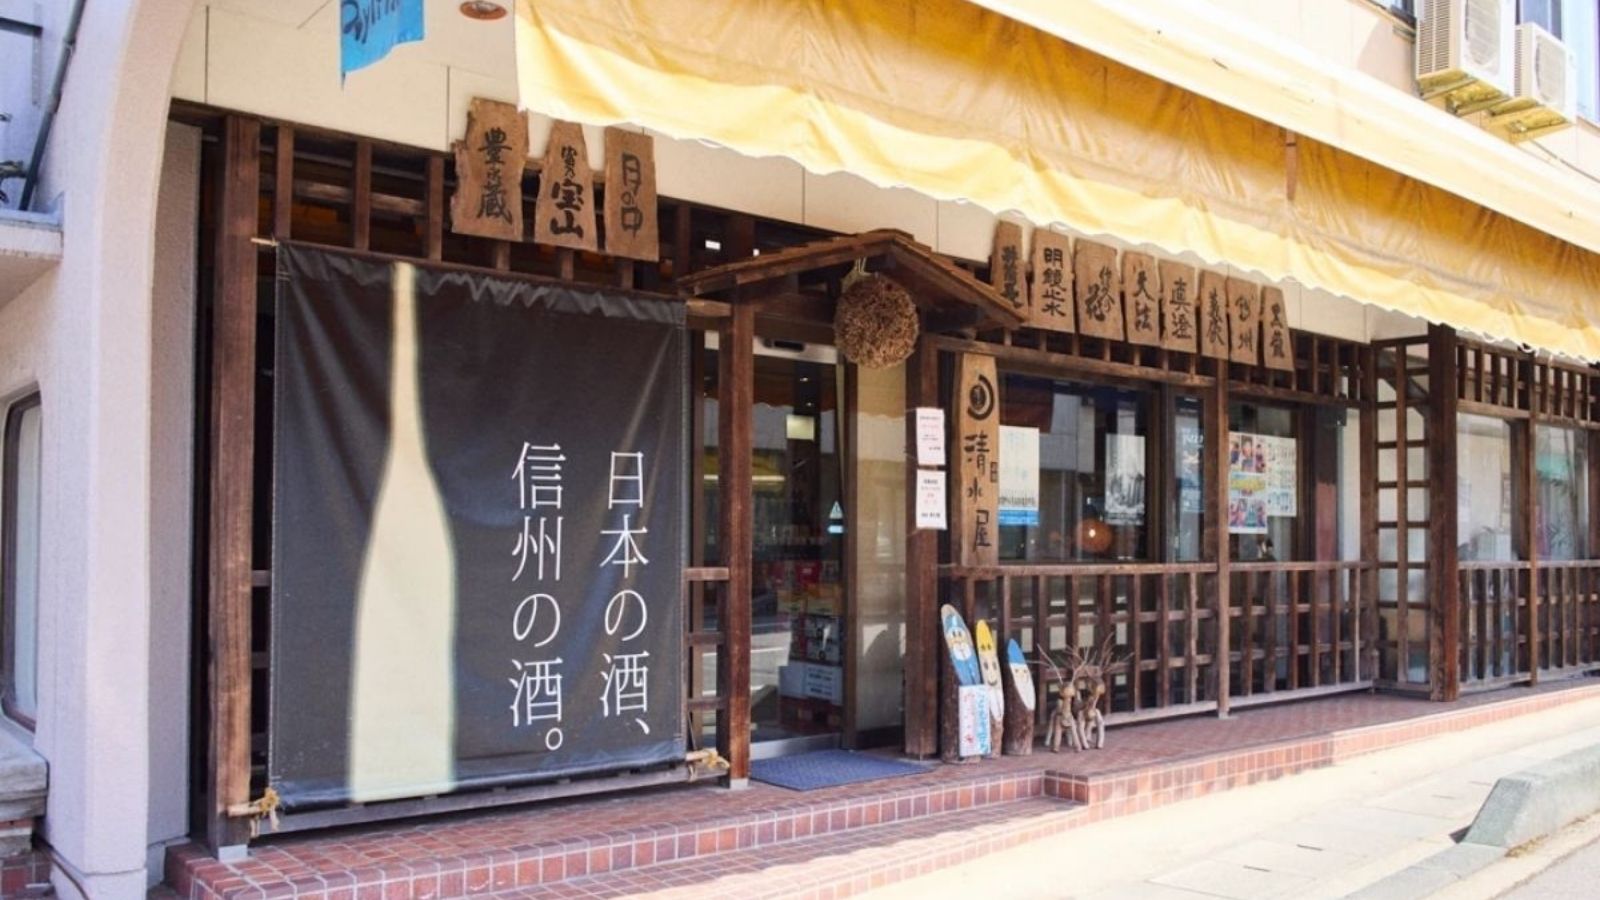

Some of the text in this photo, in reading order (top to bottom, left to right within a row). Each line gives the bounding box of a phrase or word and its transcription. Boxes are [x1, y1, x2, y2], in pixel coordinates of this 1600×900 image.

[1041, 247, 1067, 317] 明鏡止水
[1169, 276, 1193, 340] 真澄
[963, 431, 992, 550] 清水屋
[508, 441, 567, 751] 信州の酒。
[599, 450, 650, 736] 日本の酒、
